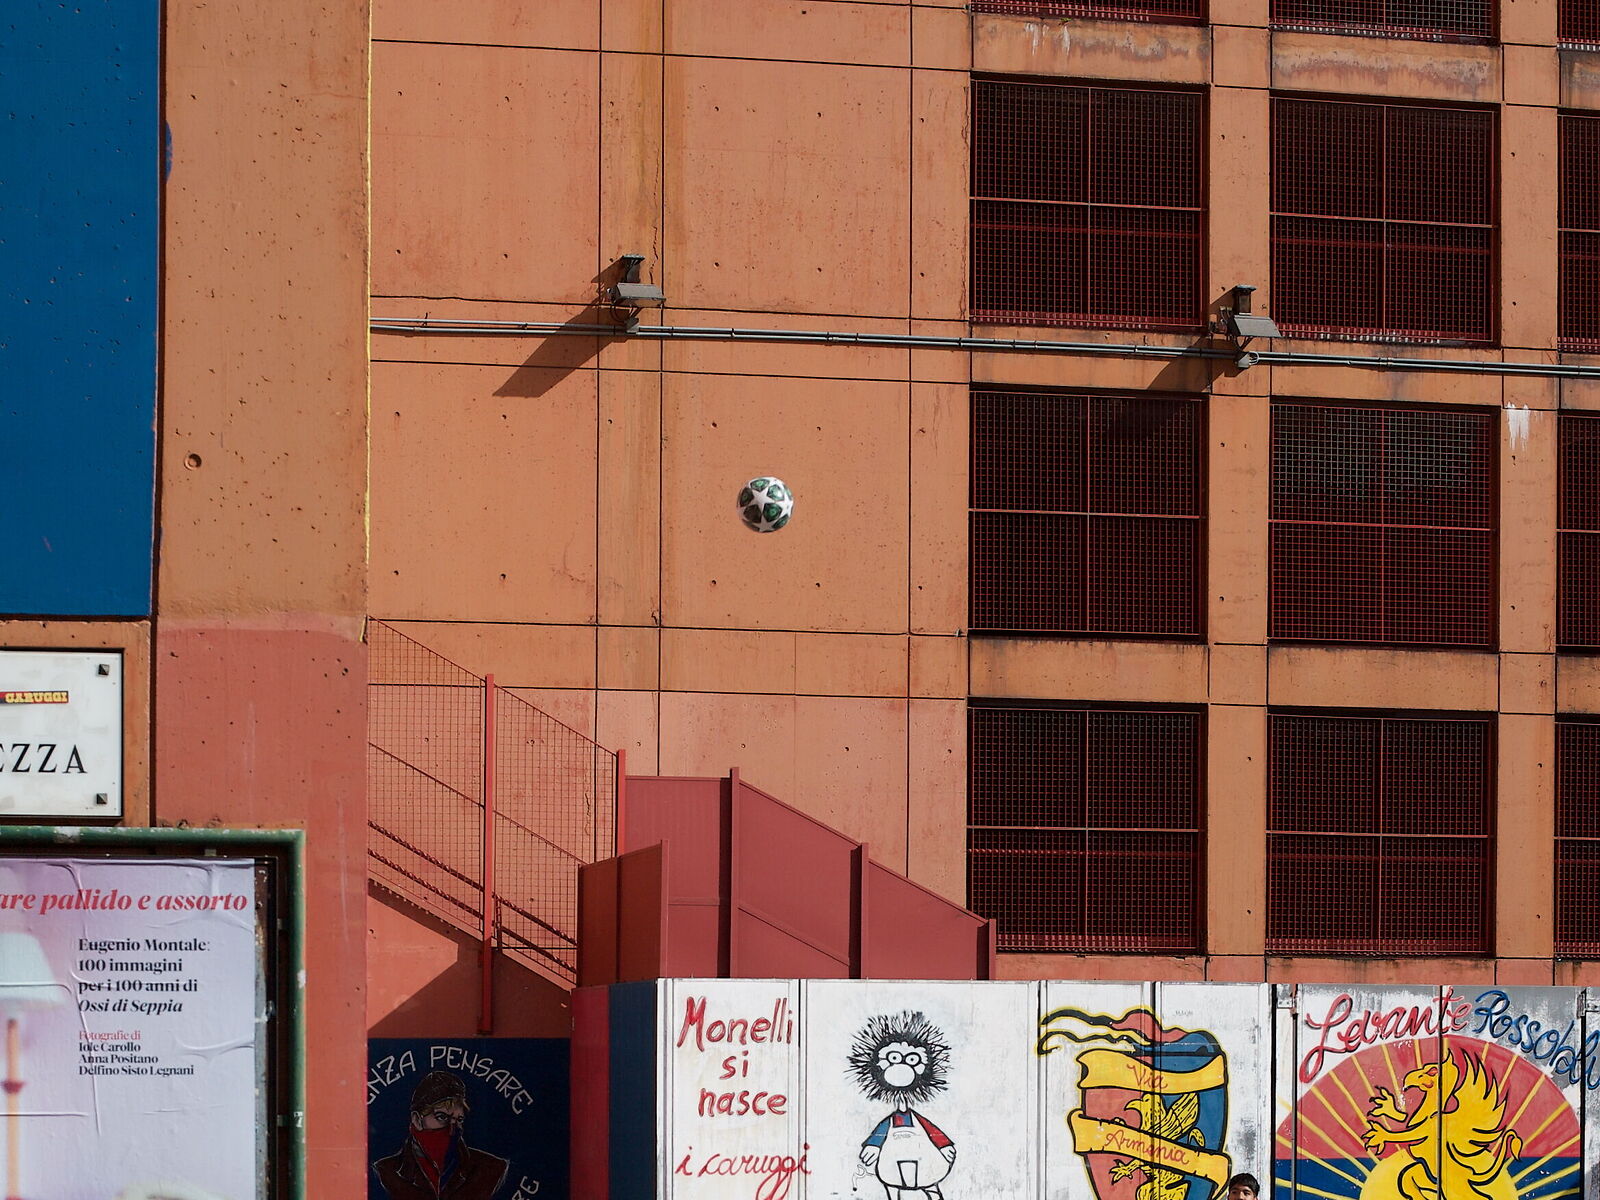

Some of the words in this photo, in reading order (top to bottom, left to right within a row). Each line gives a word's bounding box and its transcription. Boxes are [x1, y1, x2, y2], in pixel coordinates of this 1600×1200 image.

[5, 692, 68, 703] CARUGGI
[0, 743, 88, 774] ZZA
[39, 889, 132, 915] pallido
[138, 893, 152, 910] e
[156, 891, 248, 911] assorto
[78, 938, 141, 954] Eugenio
[144, 938, 210, 951] Montale:
[78, 959, 106, 972] 100
[109, 958, 183, 975] immagini
[78, 981, 101, 994] per
[107, 979, 112, 992] i
[115, 979, 142, 992] 100
[145, 979, 180, 992] anni
[183, 979, 198, 992] di
[79, 999, 109, 1012] Ossi
[112, 999, 128, 1012] di
[130, 999, 183, 1015] Seppia
[79, 1030, 129, 1042] Fotografie
[131, 1030, 141, 1040] di
[676, 995, 793, 1051] Monelli
[1299, 986, 1473, 1084] Levante
[79, 1054, 108, 1063] Anna
[111, 1054, 158, 1064] Positano
[100, 1042, 141, 1052] Carollo
[79, 1065, 119, 1075] Delfino
[121, 1065, 148, 1075] Sisto
[150, 1065, 194, 1077] Legnani
[719, 1050, 749, 1080] si
[1126, 1063, 1168, 1089] Via
[430, 1045, 534, 1115] PENSARE
[697, 1087, 788, 1118] nasce
[1104, 1129, 1190, 1165] Armenia
[674, 1146, 693, 1176] i
